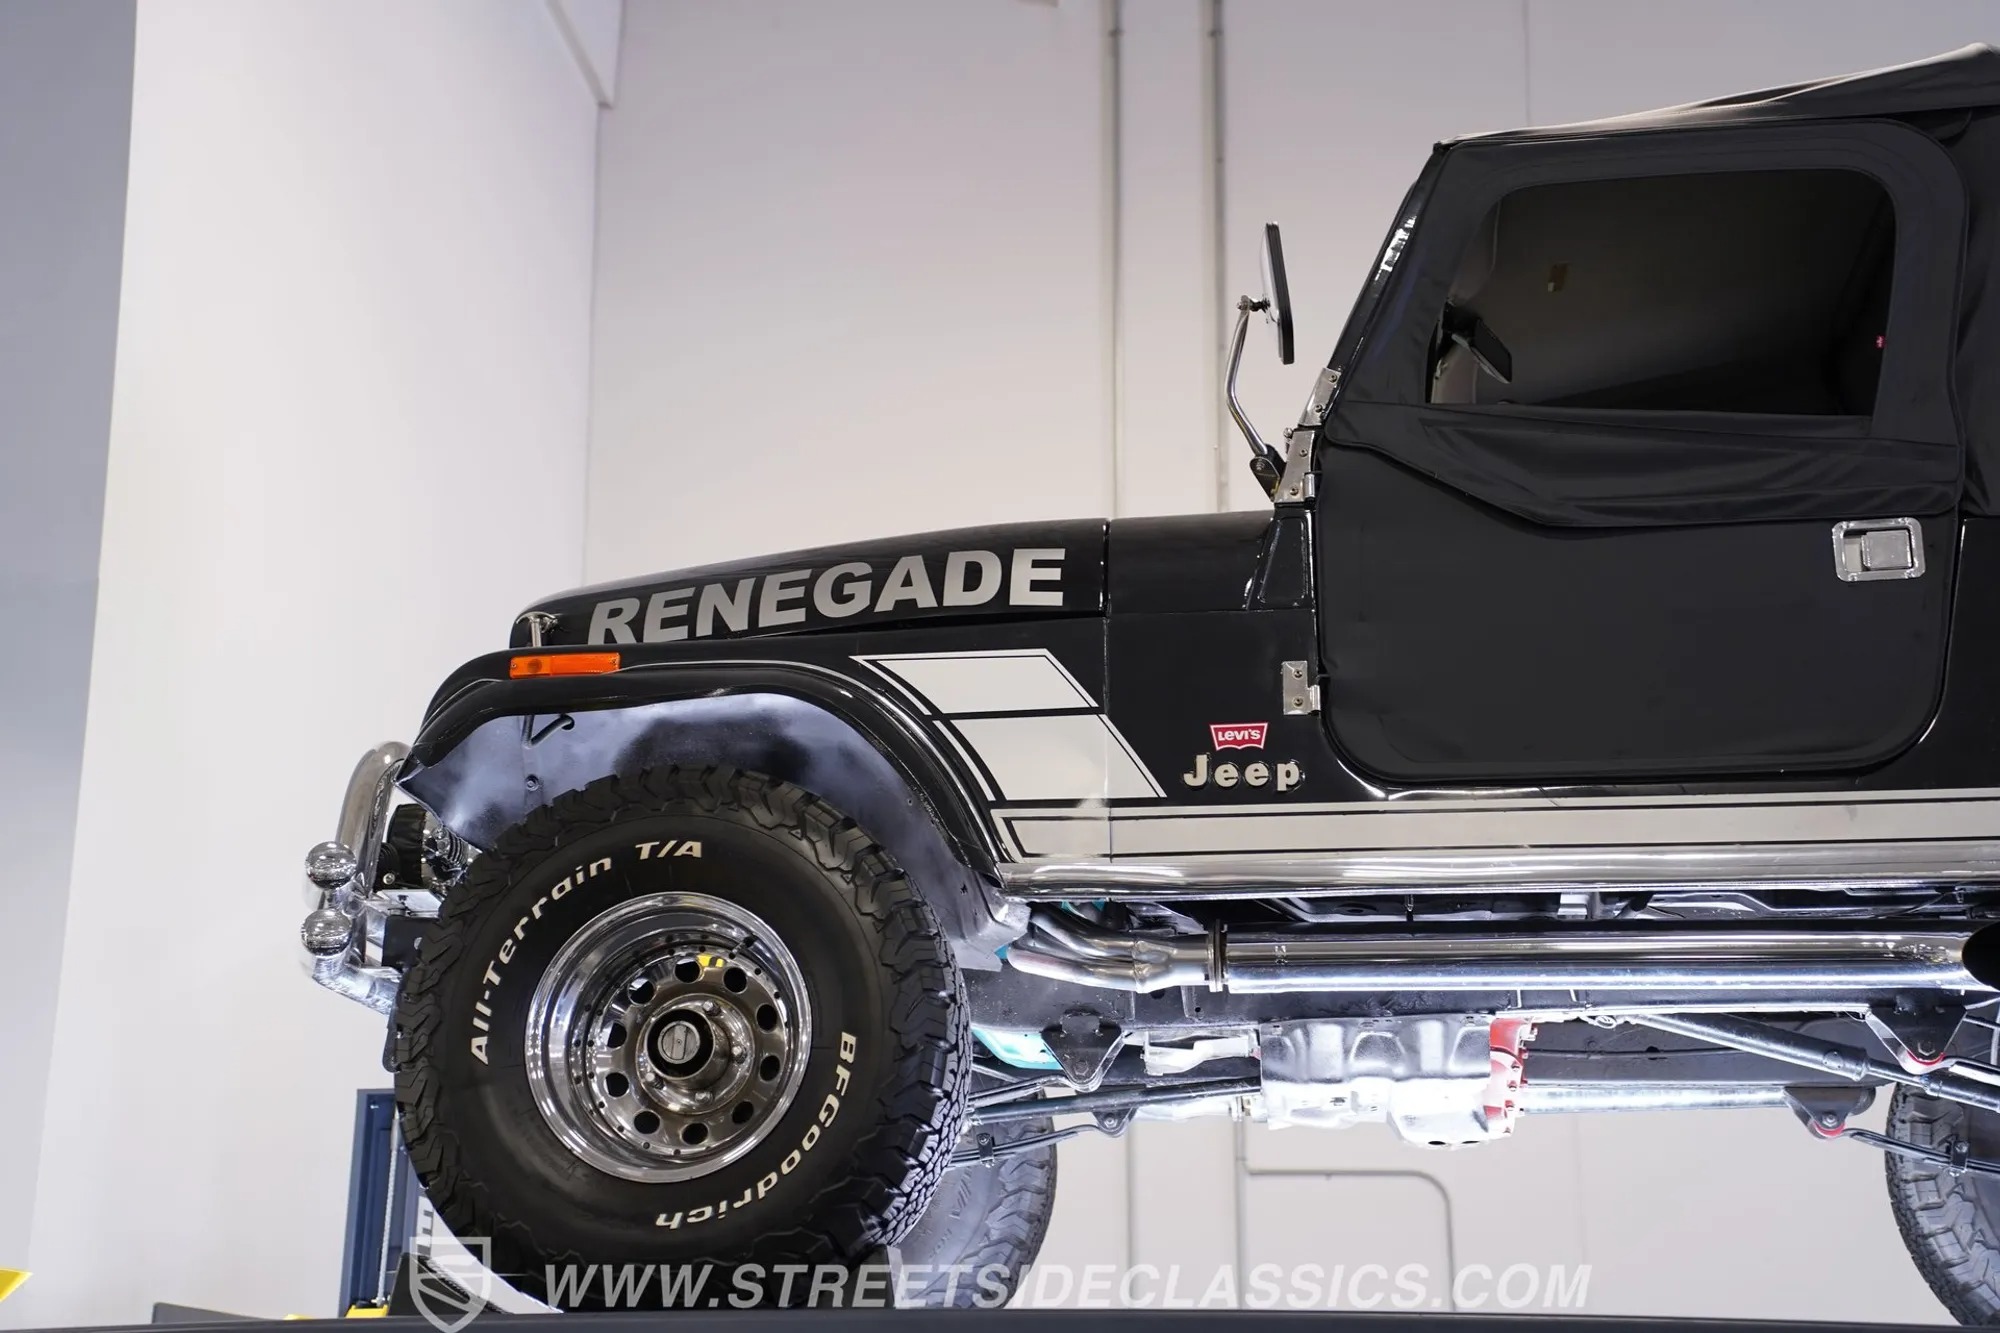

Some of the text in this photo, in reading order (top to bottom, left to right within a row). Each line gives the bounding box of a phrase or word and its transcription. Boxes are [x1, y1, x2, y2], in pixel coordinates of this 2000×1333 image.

[587, 547, 1066, 645] RENEGADE
[1183, 753, 1302, 792] Jeep
[470, 840, 703, 1066] All-Terrain T/A
[655, 1031, 857, 1230] BFGoodrich
